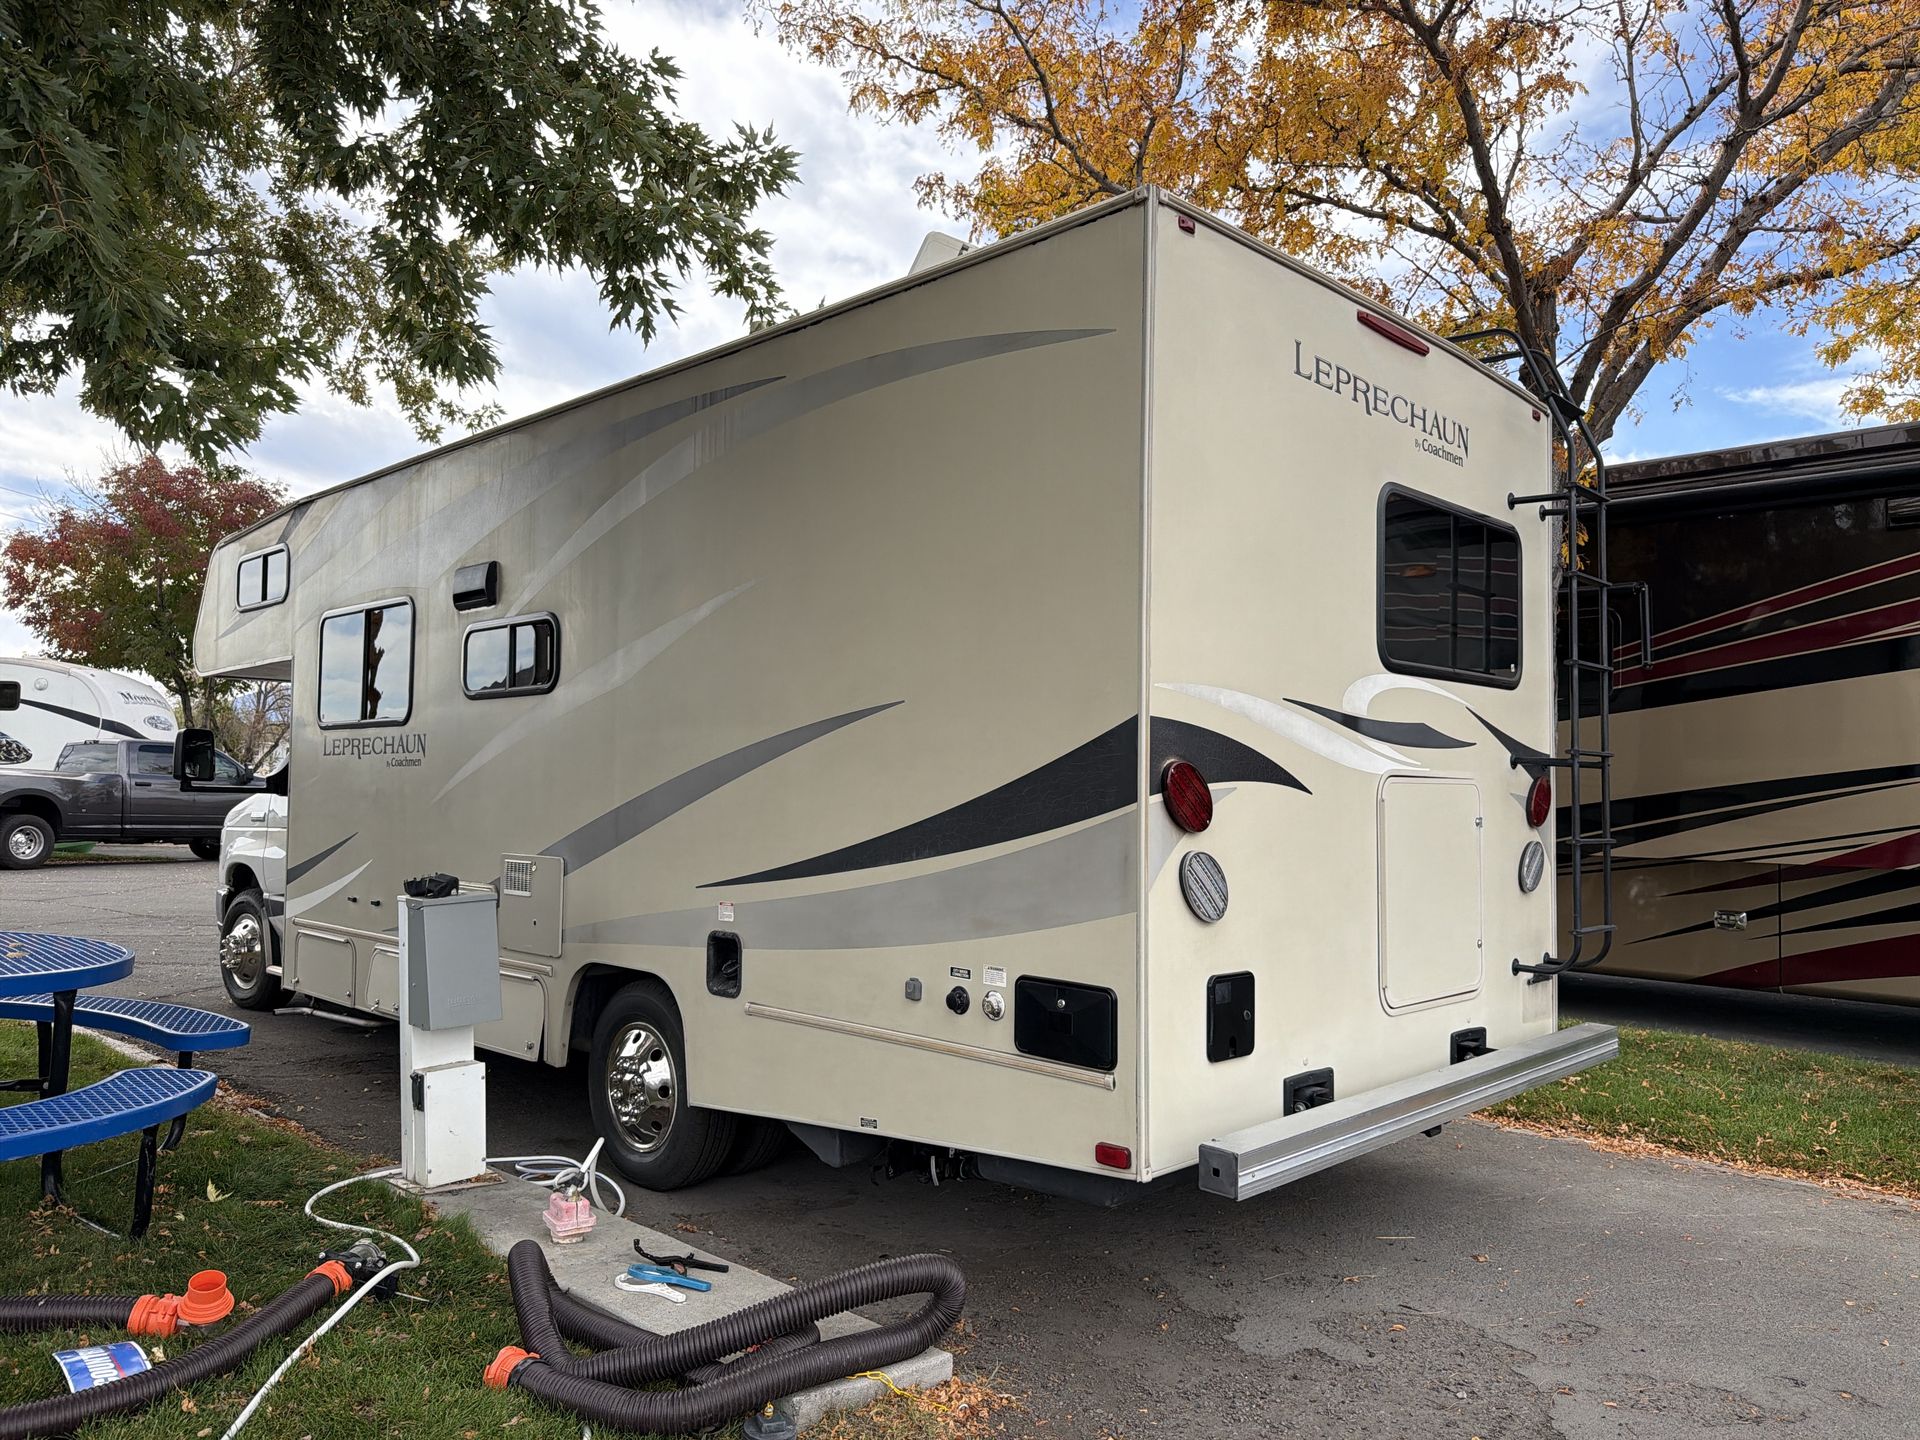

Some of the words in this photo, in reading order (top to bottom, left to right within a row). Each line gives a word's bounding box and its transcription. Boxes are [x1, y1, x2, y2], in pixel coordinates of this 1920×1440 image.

[1293, 338, 1470, 459] LEPRECHAUN
[1421, 438, 1464, 467] Coachmen
[323, 733, 427, 760] LEPRECHAUN
[391, 756, 422, 768] Coachmen
